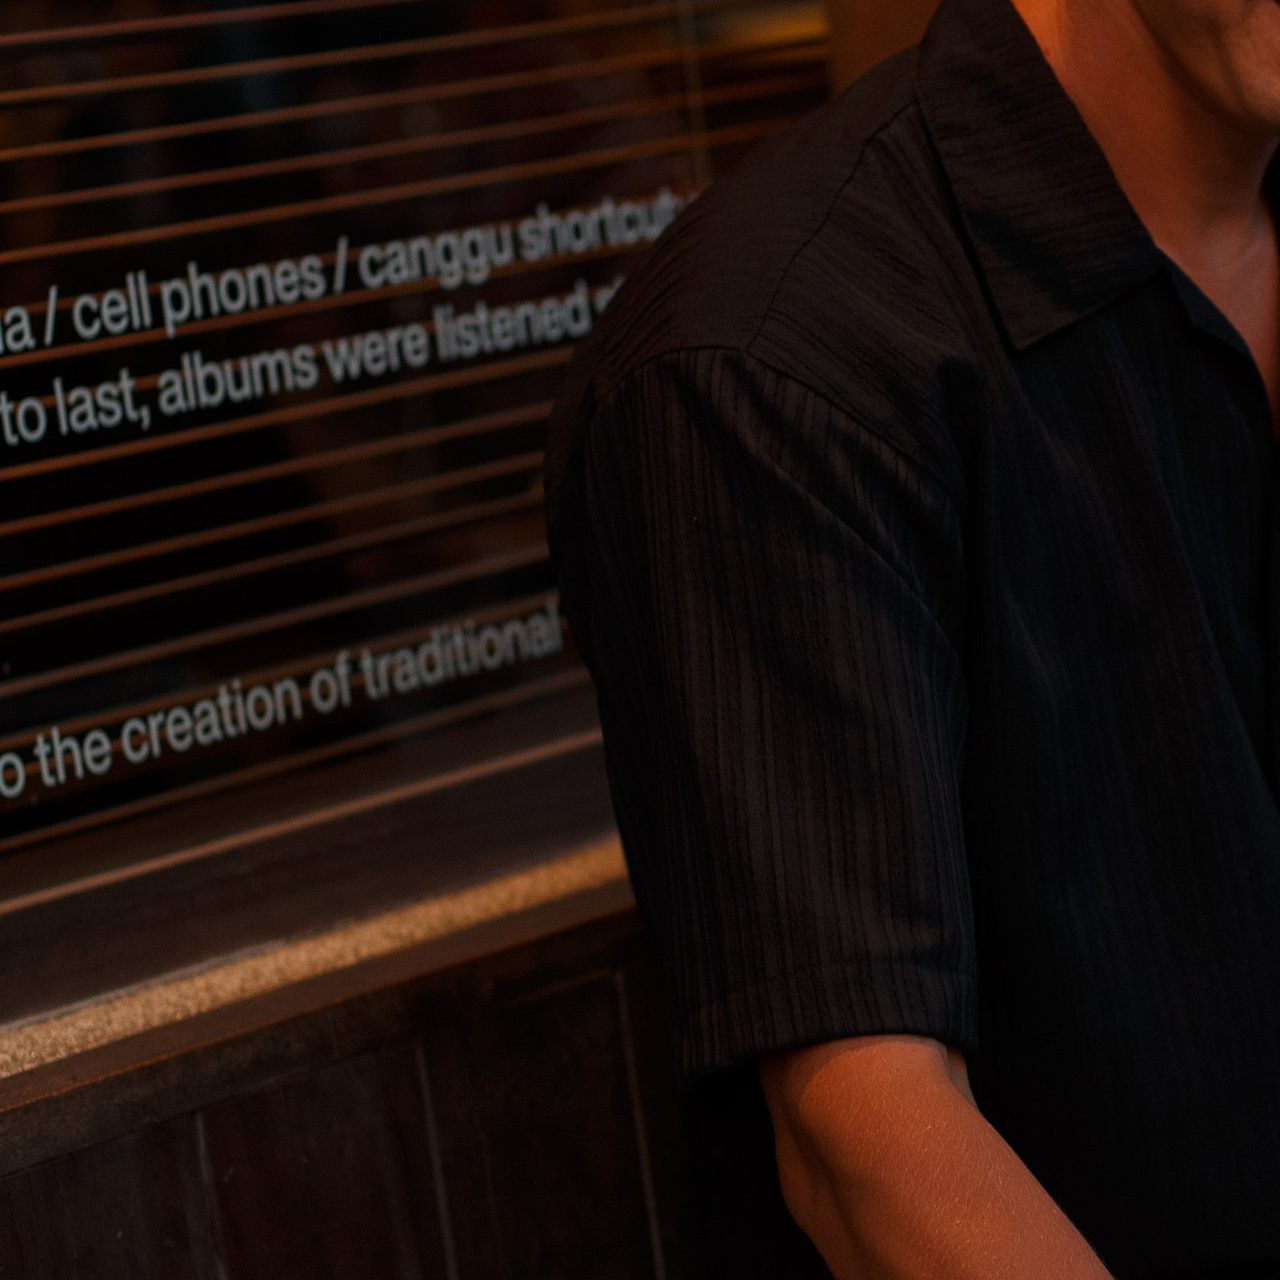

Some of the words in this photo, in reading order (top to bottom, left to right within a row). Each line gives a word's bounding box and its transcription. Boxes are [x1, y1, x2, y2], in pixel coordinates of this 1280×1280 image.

[0, 305, 36, 355] a
[72, 269, 152, 340] cell
[160, 260, 328, 339] phones
[358, 224, 514, 291] canggu
[518, 186, 699, 261] shortcut
[0, 390, 47, 446] to
[52, 367, 151, 436] last,
[158, 350, 320, 416] albums
[321, 323, 431, 383] were
[432, 277, 593, 362] listened
[33, 724, 113, 788] the
[121, 677, 303, 764] creation
[310, 648, 351, 714] of
[360, 596, 564, 700] traditional
